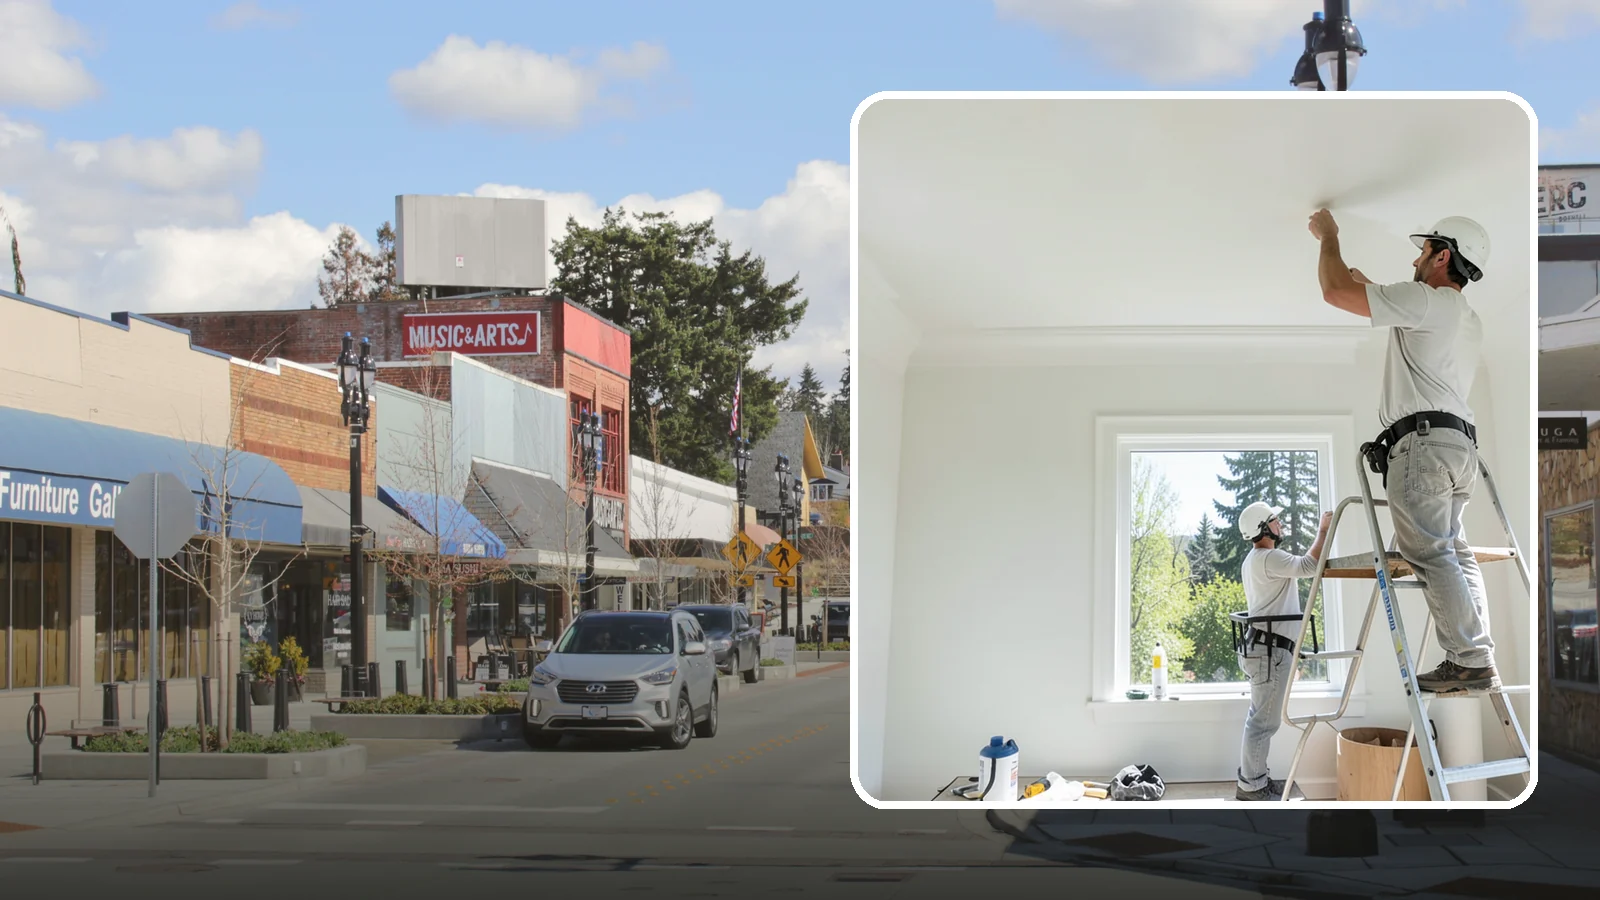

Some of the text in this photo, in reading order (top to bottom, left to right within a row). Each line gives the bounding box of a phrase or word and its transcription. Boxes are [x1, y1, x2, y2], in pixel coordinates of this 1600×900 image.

[409, 323, 520, 349] MUSIC&ARTS
[0, 471, 79, 516] Furniture
[453, 563, 479, 574] SUSHI
